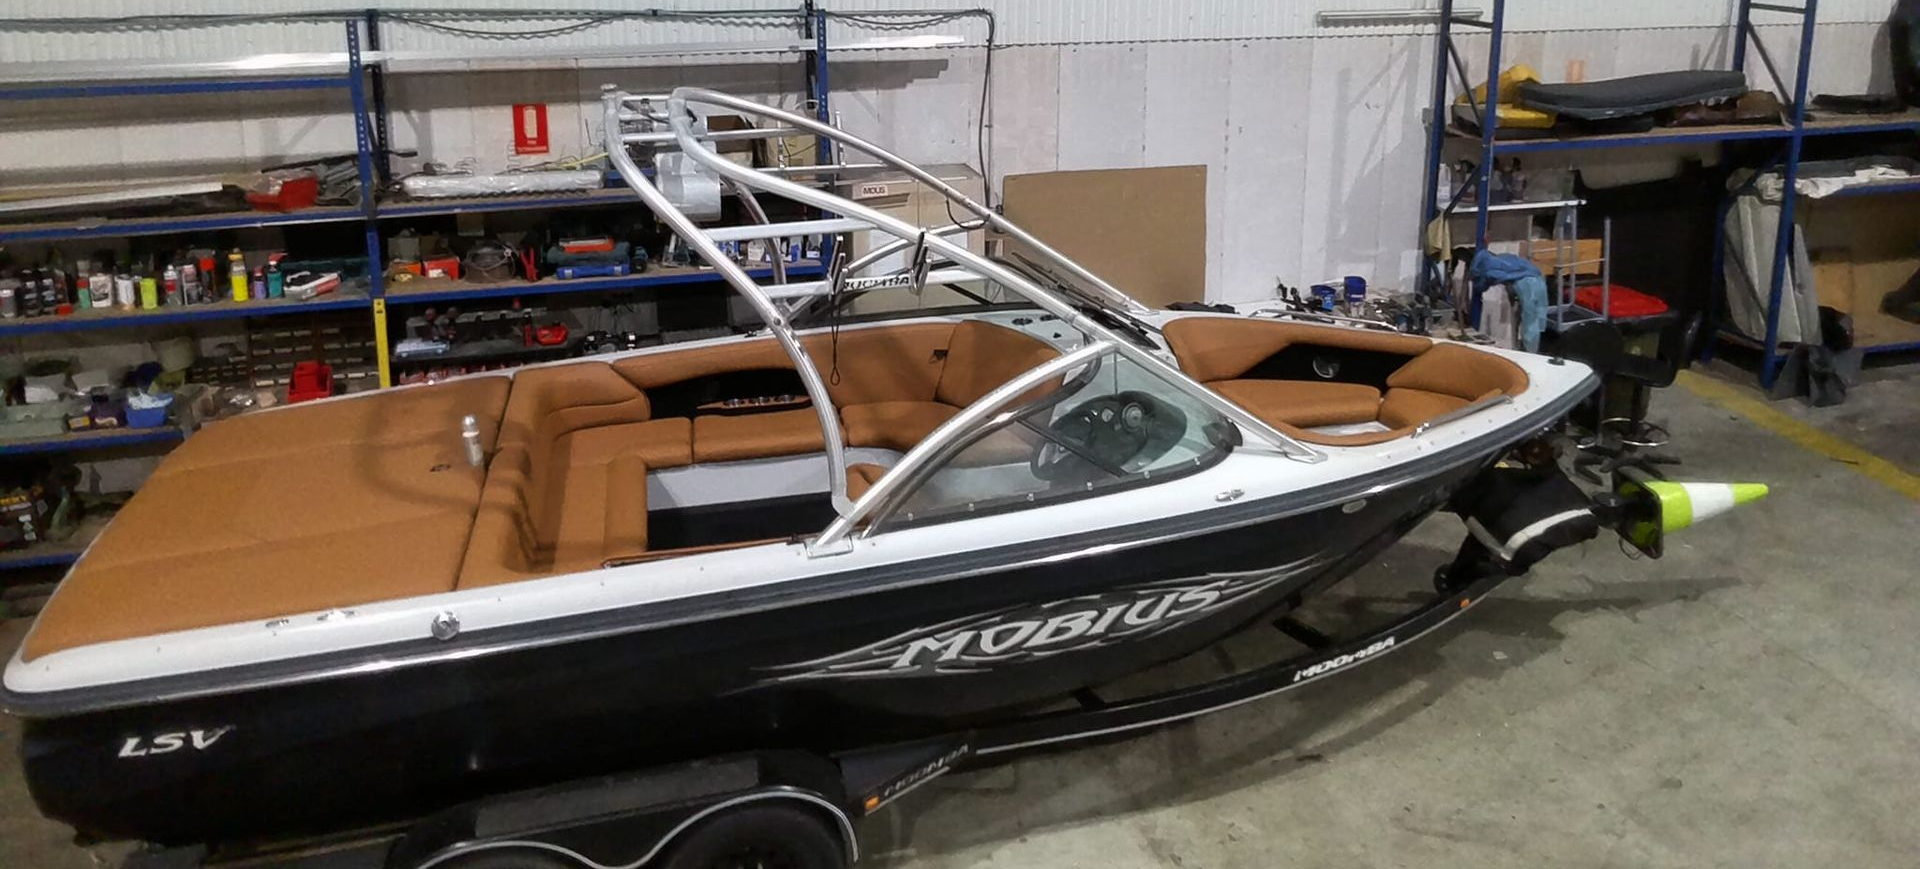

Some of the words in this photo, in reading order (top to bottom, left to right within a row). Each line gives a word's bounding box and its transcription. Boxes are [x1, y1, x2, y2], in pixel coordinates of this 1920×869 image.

[890, 580, 1230, 669] MOBIUS
[1293, 636, 1395, 682] MOOMBA
[118, 725, 236, 757] LSV
